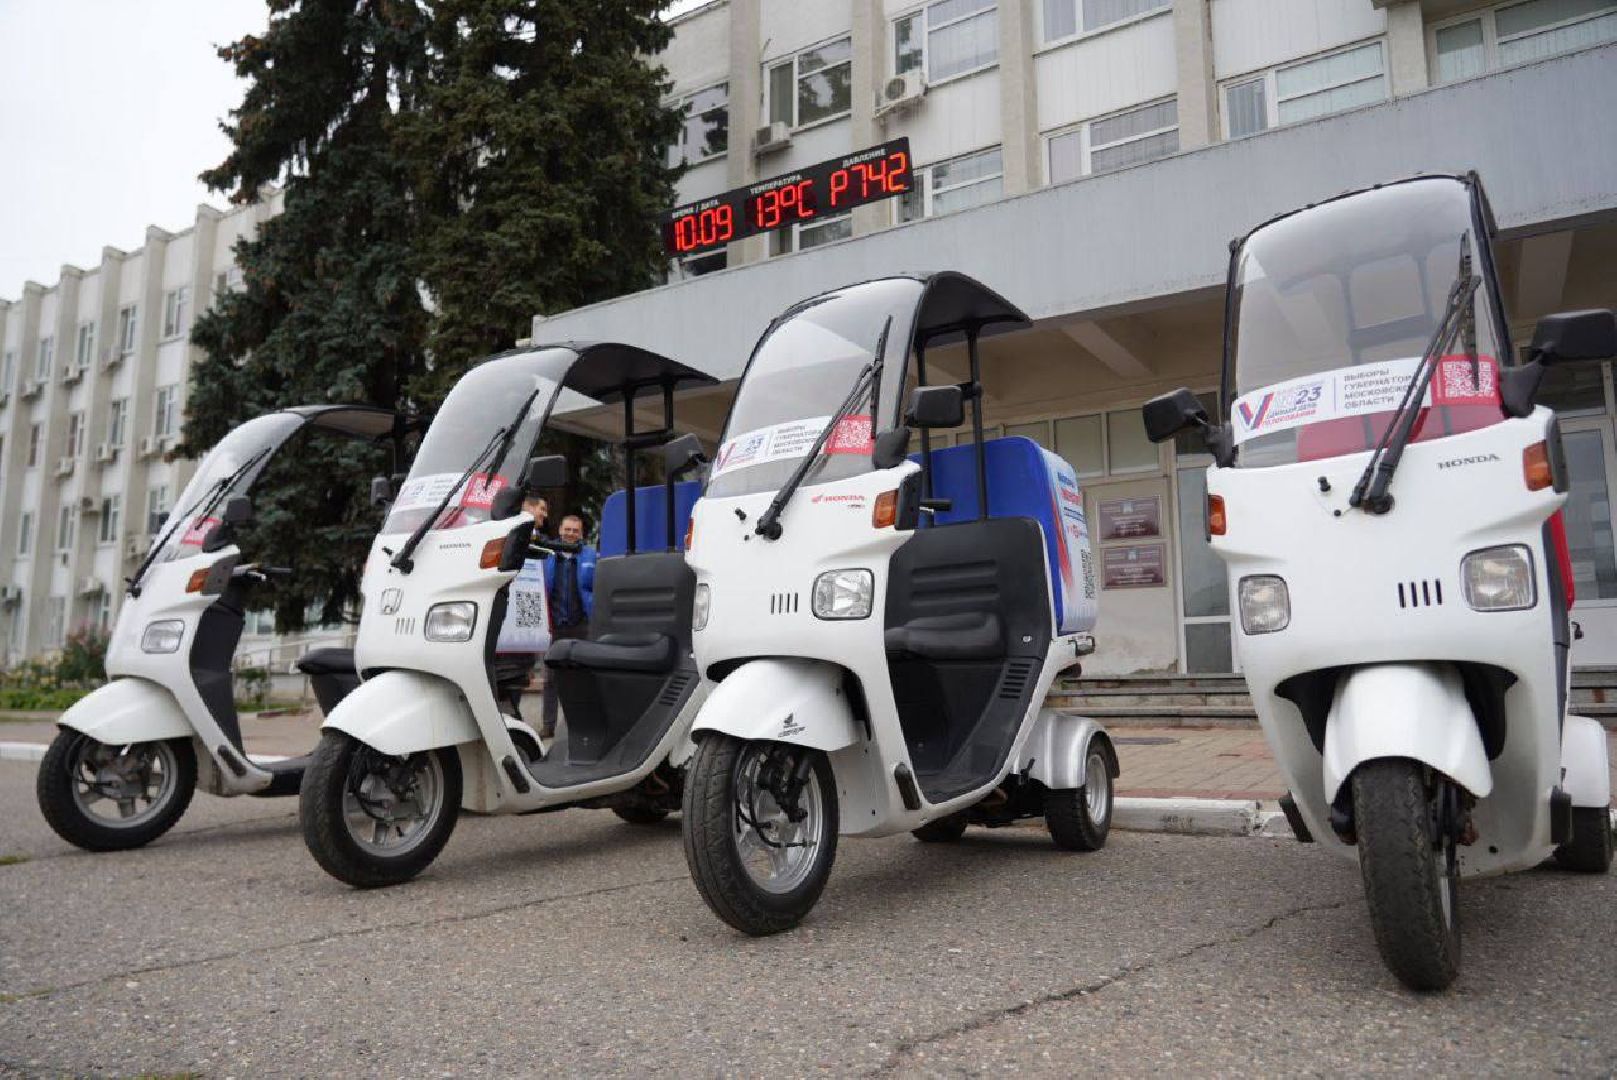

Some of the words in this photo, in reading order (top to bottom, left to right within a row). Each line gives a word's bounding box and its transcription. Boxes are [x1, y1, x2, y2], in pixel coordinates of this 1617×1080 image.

[674, 204, 733, 251] 10.09
[1344, 368, 1389, 381] ВЫБОРЫ
[1344, 375, 1412, 391] ГУБЕРНАТОР
[1344, 384, 1409, 400] МОСКОВСКО
[1344, 396, 1394, 409] ОБЛАСТИ
[1437, 454, 1500, 469] HONDA
[825, 494, 865, 502] HONDA
